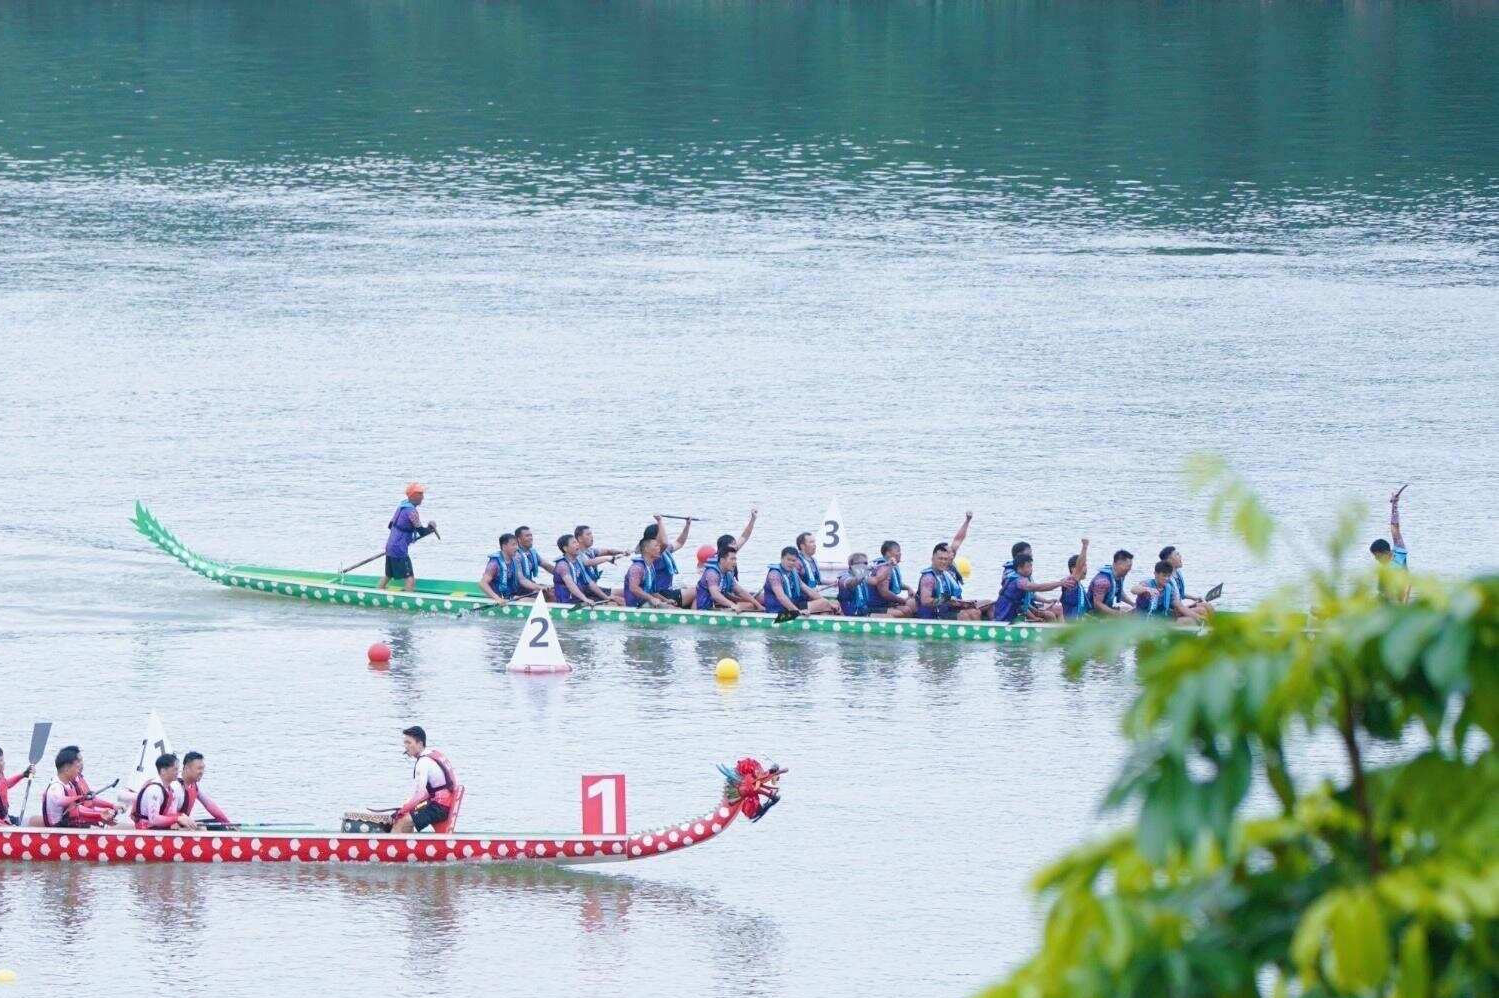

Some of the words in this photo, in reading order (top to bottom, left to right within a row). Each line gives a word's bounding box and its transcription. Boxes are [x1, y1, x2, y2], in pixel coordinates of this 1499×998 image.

[823, 520, 839, 548] 3
[529, 617, 549, 647] 2
[588, 778, 617, 834] 1
